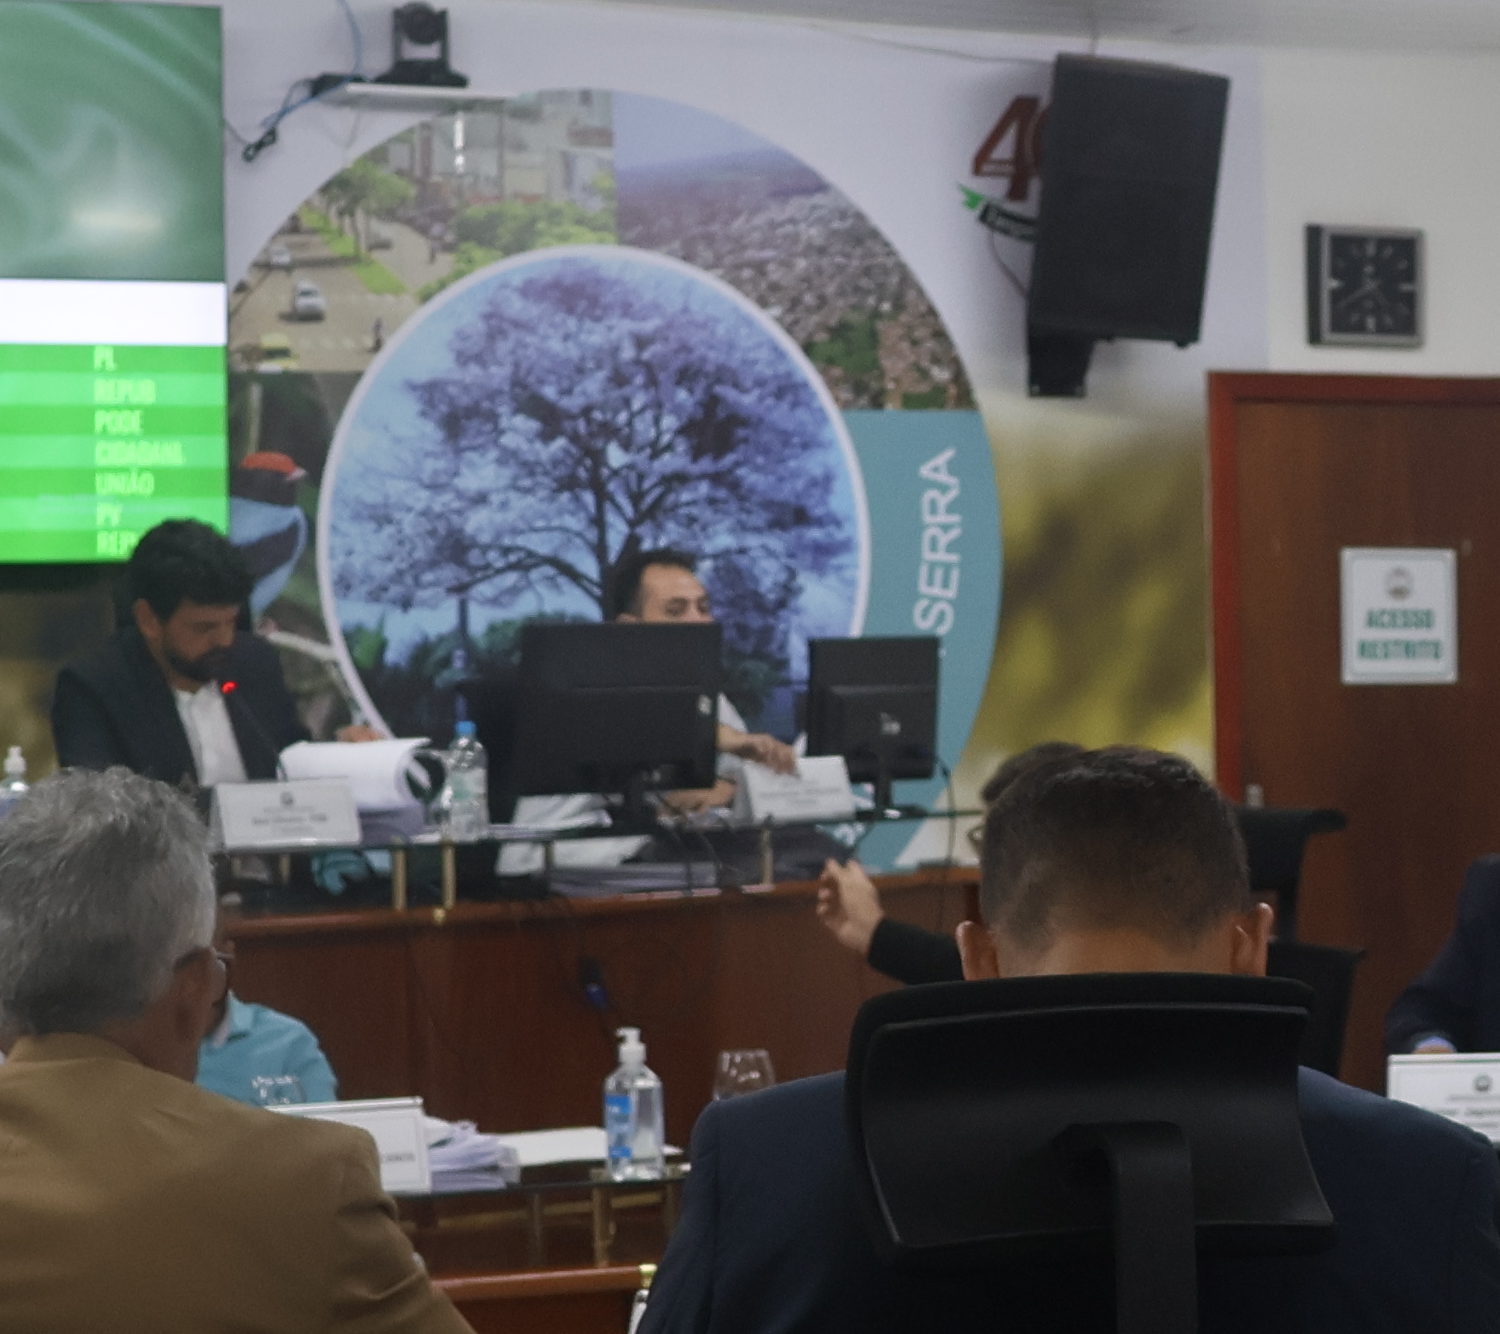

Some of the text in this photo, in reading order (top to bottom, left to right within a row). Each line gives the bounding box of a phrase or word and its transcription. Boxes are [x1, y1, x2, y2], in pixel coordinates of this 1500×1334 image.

[972, 94, 1053, 201] 4
[913, 446, 963, 636] SERRA
[1358, 639, 1441, 660] RESTRITO
[1366, 609, 1435, 629] ACESSO
